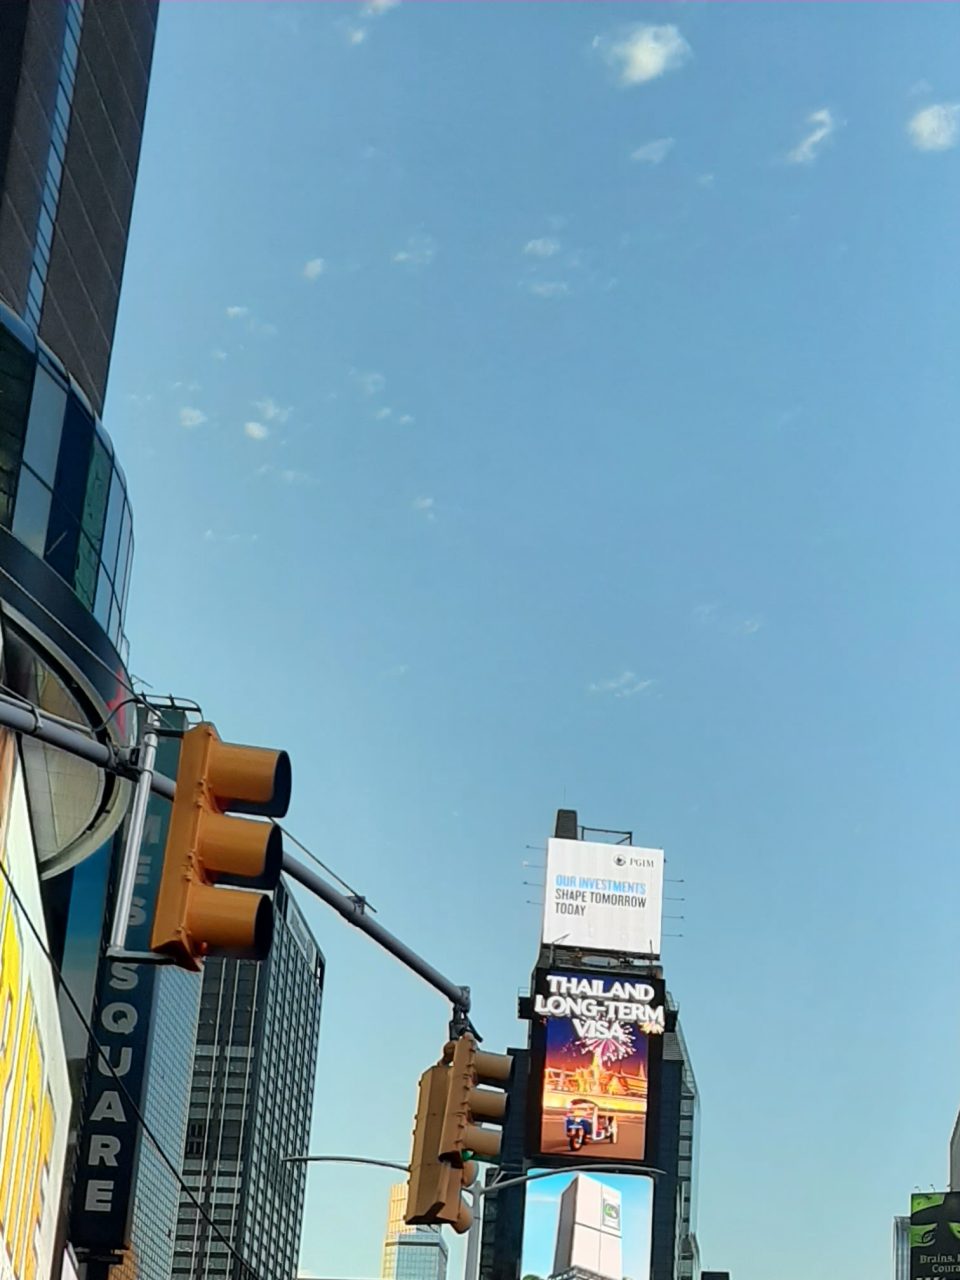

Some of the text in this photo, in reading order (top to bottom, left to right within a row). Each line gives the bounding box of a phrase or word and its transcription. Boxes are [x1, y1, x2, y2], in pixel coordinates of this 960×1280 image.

[555, 874, 647, 895] OUR INVESTMENTS
[555, 888, 647, 909] SHAPE TOMORROW
[555, 902, 586, 917] TODAY
[546, 975, 656, 1002] THAILAND
[534, 994, 666, 1027] LONG-TERM
[572, 1017, 624, 1040] VISA
[84, 961, 141, 1212] SQUARE
[920, 1253, 955, 1264] Brains.
